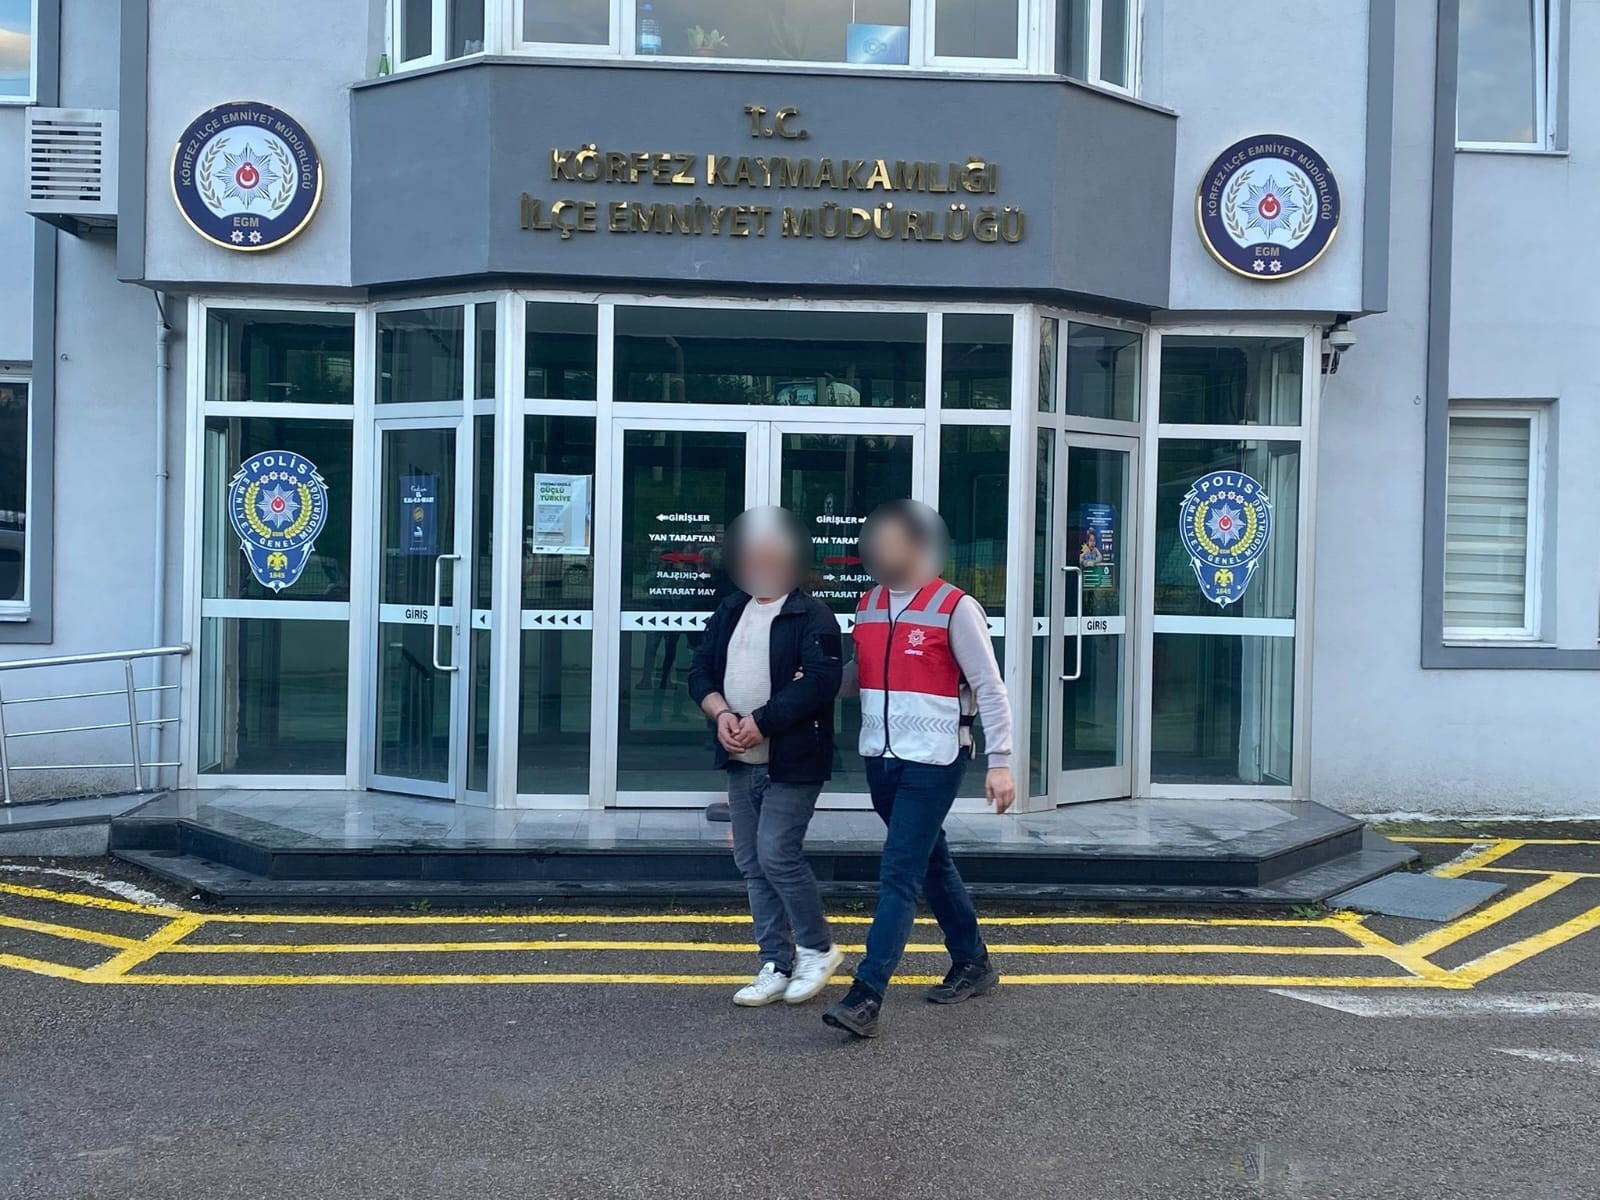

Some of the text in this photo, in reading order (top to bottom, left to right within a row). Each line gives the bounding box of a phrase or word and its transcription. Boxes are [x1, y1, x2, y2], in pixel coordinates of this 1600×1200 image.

[744, 103, 808, 139] T.C.
[181, 110, 313, 190] KÖRFEZ İLÇE EMNİYET MÜDÜRLÜĞÜ
[550, 143, 998, 194] KÖRFEZ KAYMAKAMLIĞI
[1208, 142, 1333, 220] KÖRFEZ İLÇE EMNİYET MÜDÜRLÜĞÜ
[233, 216, 260, 228] EGM
[519, 192, 1026, 243] İLÇE EMNİYET MÜDÜRLÜĞÜ
[1255, 246, 1280, 257] EGM
[250, 455, 308, 475] POLİS
[1200, 476, 1254, 494] POLİS
[669, 513, 710, 523] GİRİŞLER
[816, 515, 857, 525] GİRİŞLER
[259, 537, 296, 549] GENEL
[648, 533, 716, 543] YAN TARAFTAN
[811, 536, 860, 545] YAN TARAF
[1207, 555, 1242, 565] GENEL
[405, 608, 429, 623] GİRİŞ
[1086, 618, 1108, 632] GİRİŞ
